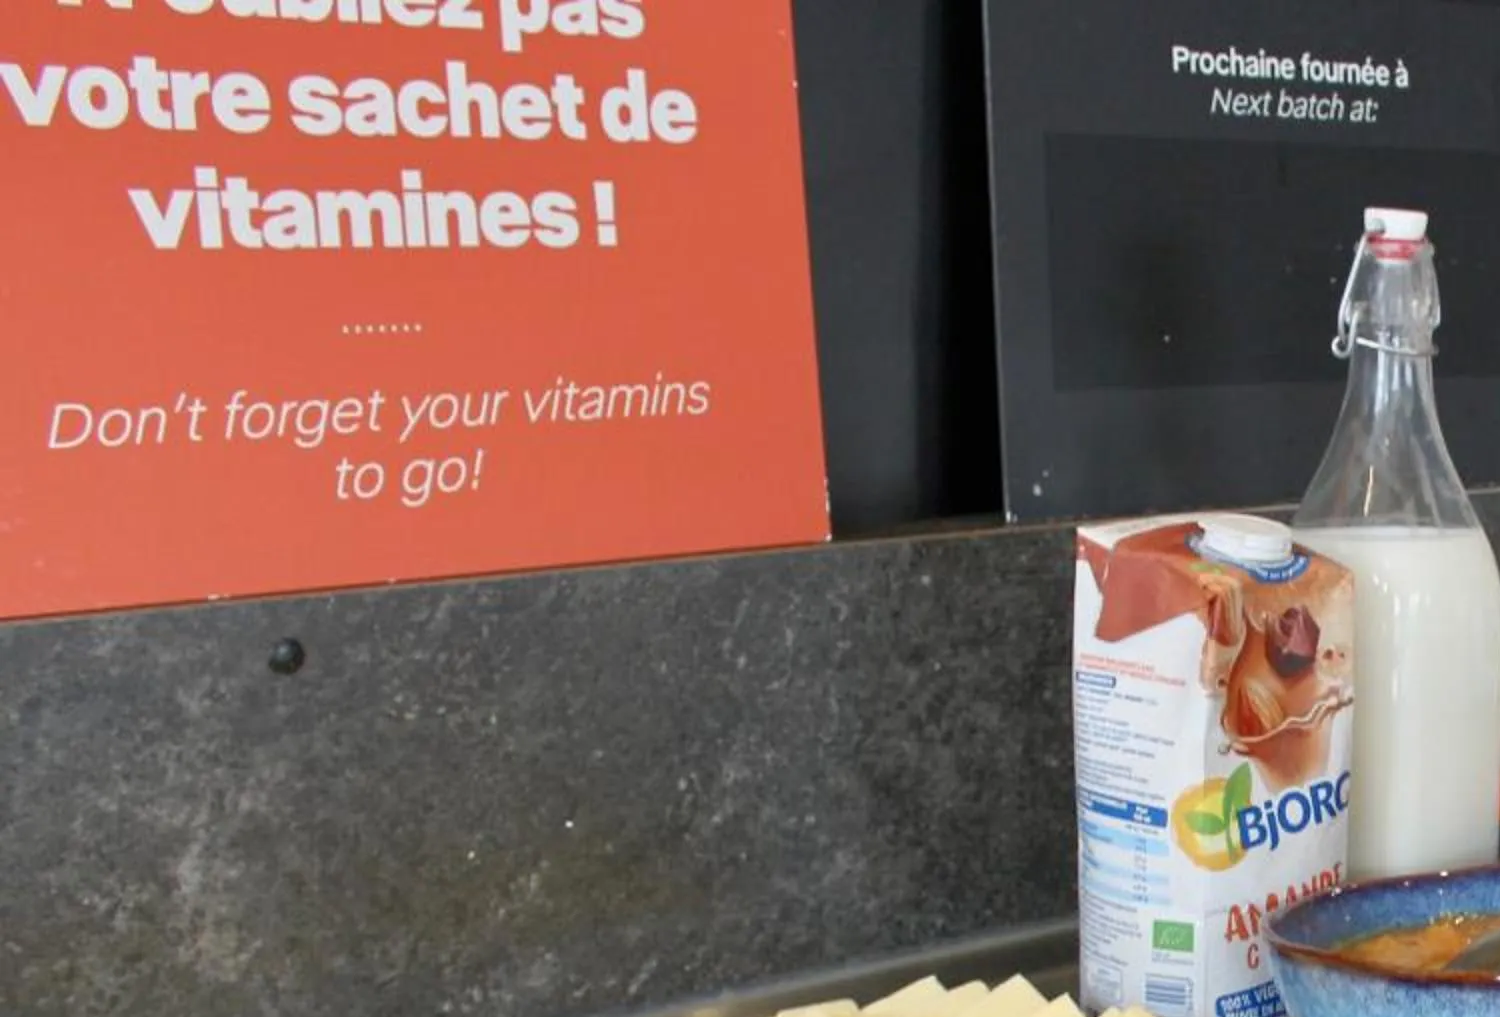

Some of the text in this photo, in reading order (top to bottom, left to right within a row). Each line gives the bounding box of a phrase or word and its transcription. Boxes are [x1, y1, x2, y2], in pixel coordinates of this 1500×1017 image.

[500, 0, 645, 52] pas
[1171, 45, 1409, 88] Prochaine fournée à
[0, 57, 697, 143] votre sachet de
[1210, 87, 1380, 123] Next batch at:
[127, 167, 580, 250] vitamines
[46, 371, 711, 449] Don't forget your vitamins
[335, 449, 485, 507] to go!
